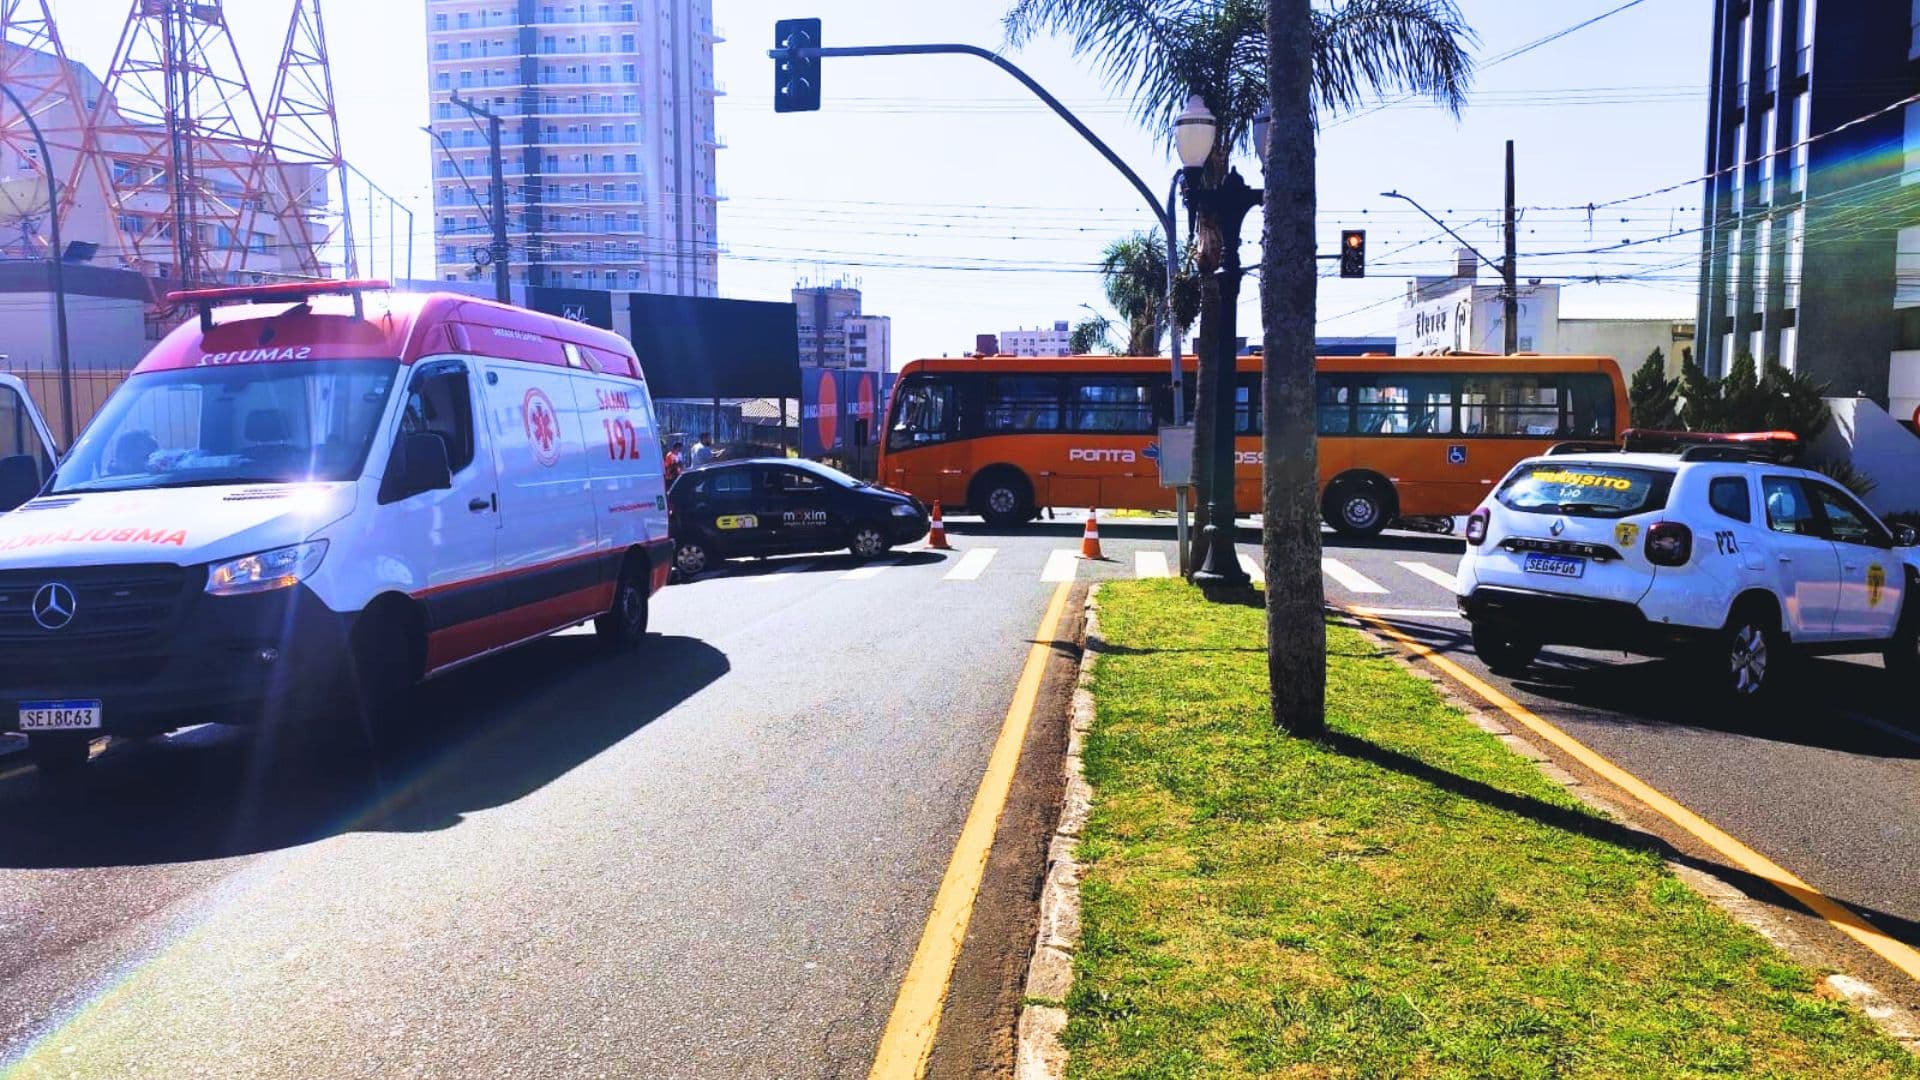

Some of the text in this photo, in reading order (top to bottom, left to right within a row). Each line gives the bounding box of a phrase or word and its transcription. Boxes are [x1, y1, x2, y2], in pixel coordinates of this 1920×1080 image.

[595, 387, 630, 412] SAMU
[603, 419, 640, 461] 192
[1714, 530, 1740, 556] P27
